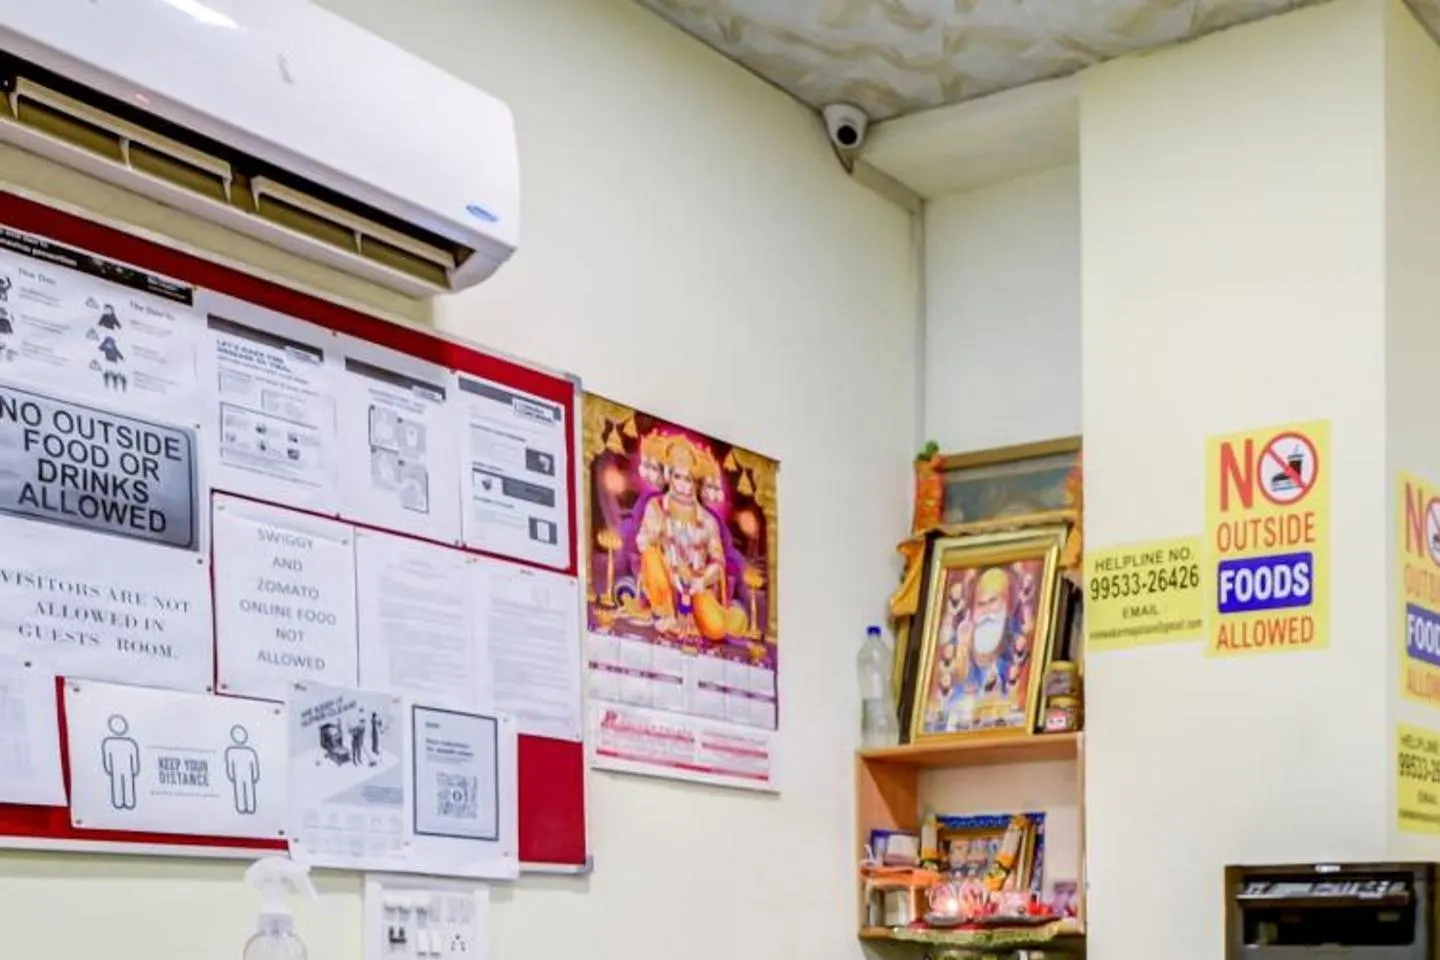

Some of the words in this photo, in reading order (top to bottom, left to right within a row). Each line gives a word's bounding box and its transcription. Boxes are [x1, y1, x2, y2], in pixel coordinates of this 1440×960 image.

[0, 395, 41, 427] NO
[53, 410, 182, 461] OUTSIDE
[24, 429, 109, 468] FOOD
[120, 452, 160, 481] OR
[38, 458, 149, 504] DRINKS
[18, 482, 167, 533] ALLOWED
[257, 528, 314, 550] SWIGGY
[1216, 512, 1315, 553] OUTSIDE
[272, 557, 303, 572] AND
[1095, 549, 1164, 573] HELPLINE
[0, 569, 101, 598] VISITORS
[108, 588, 147, 606] ARE
[154, 596, 190, 614] NOT
[256, 577, 320, 600] ZOMATO
[1090, 564, 1199, 602] 99533-26426
[1220, 562, 1310, 604] FOODS
[34, 601, 138, 629] ALLOWED
[144, 618, 165, 632] IN
[239, 598, 293, 619] ONLINE
[297, 609, 337, 626] FOOD
[18, 623, 101, 646] GUESTS
[275, 627, 305, 643] NOT
[1216, 615, 1315, 650] ALLOWED
[256, 649, 326, 671] ALLOWED
[157, 757, 182, 772] KEEP
[183, 758, 208, 773] YOUR
[159, 770, 209, 788] DISTANCE
